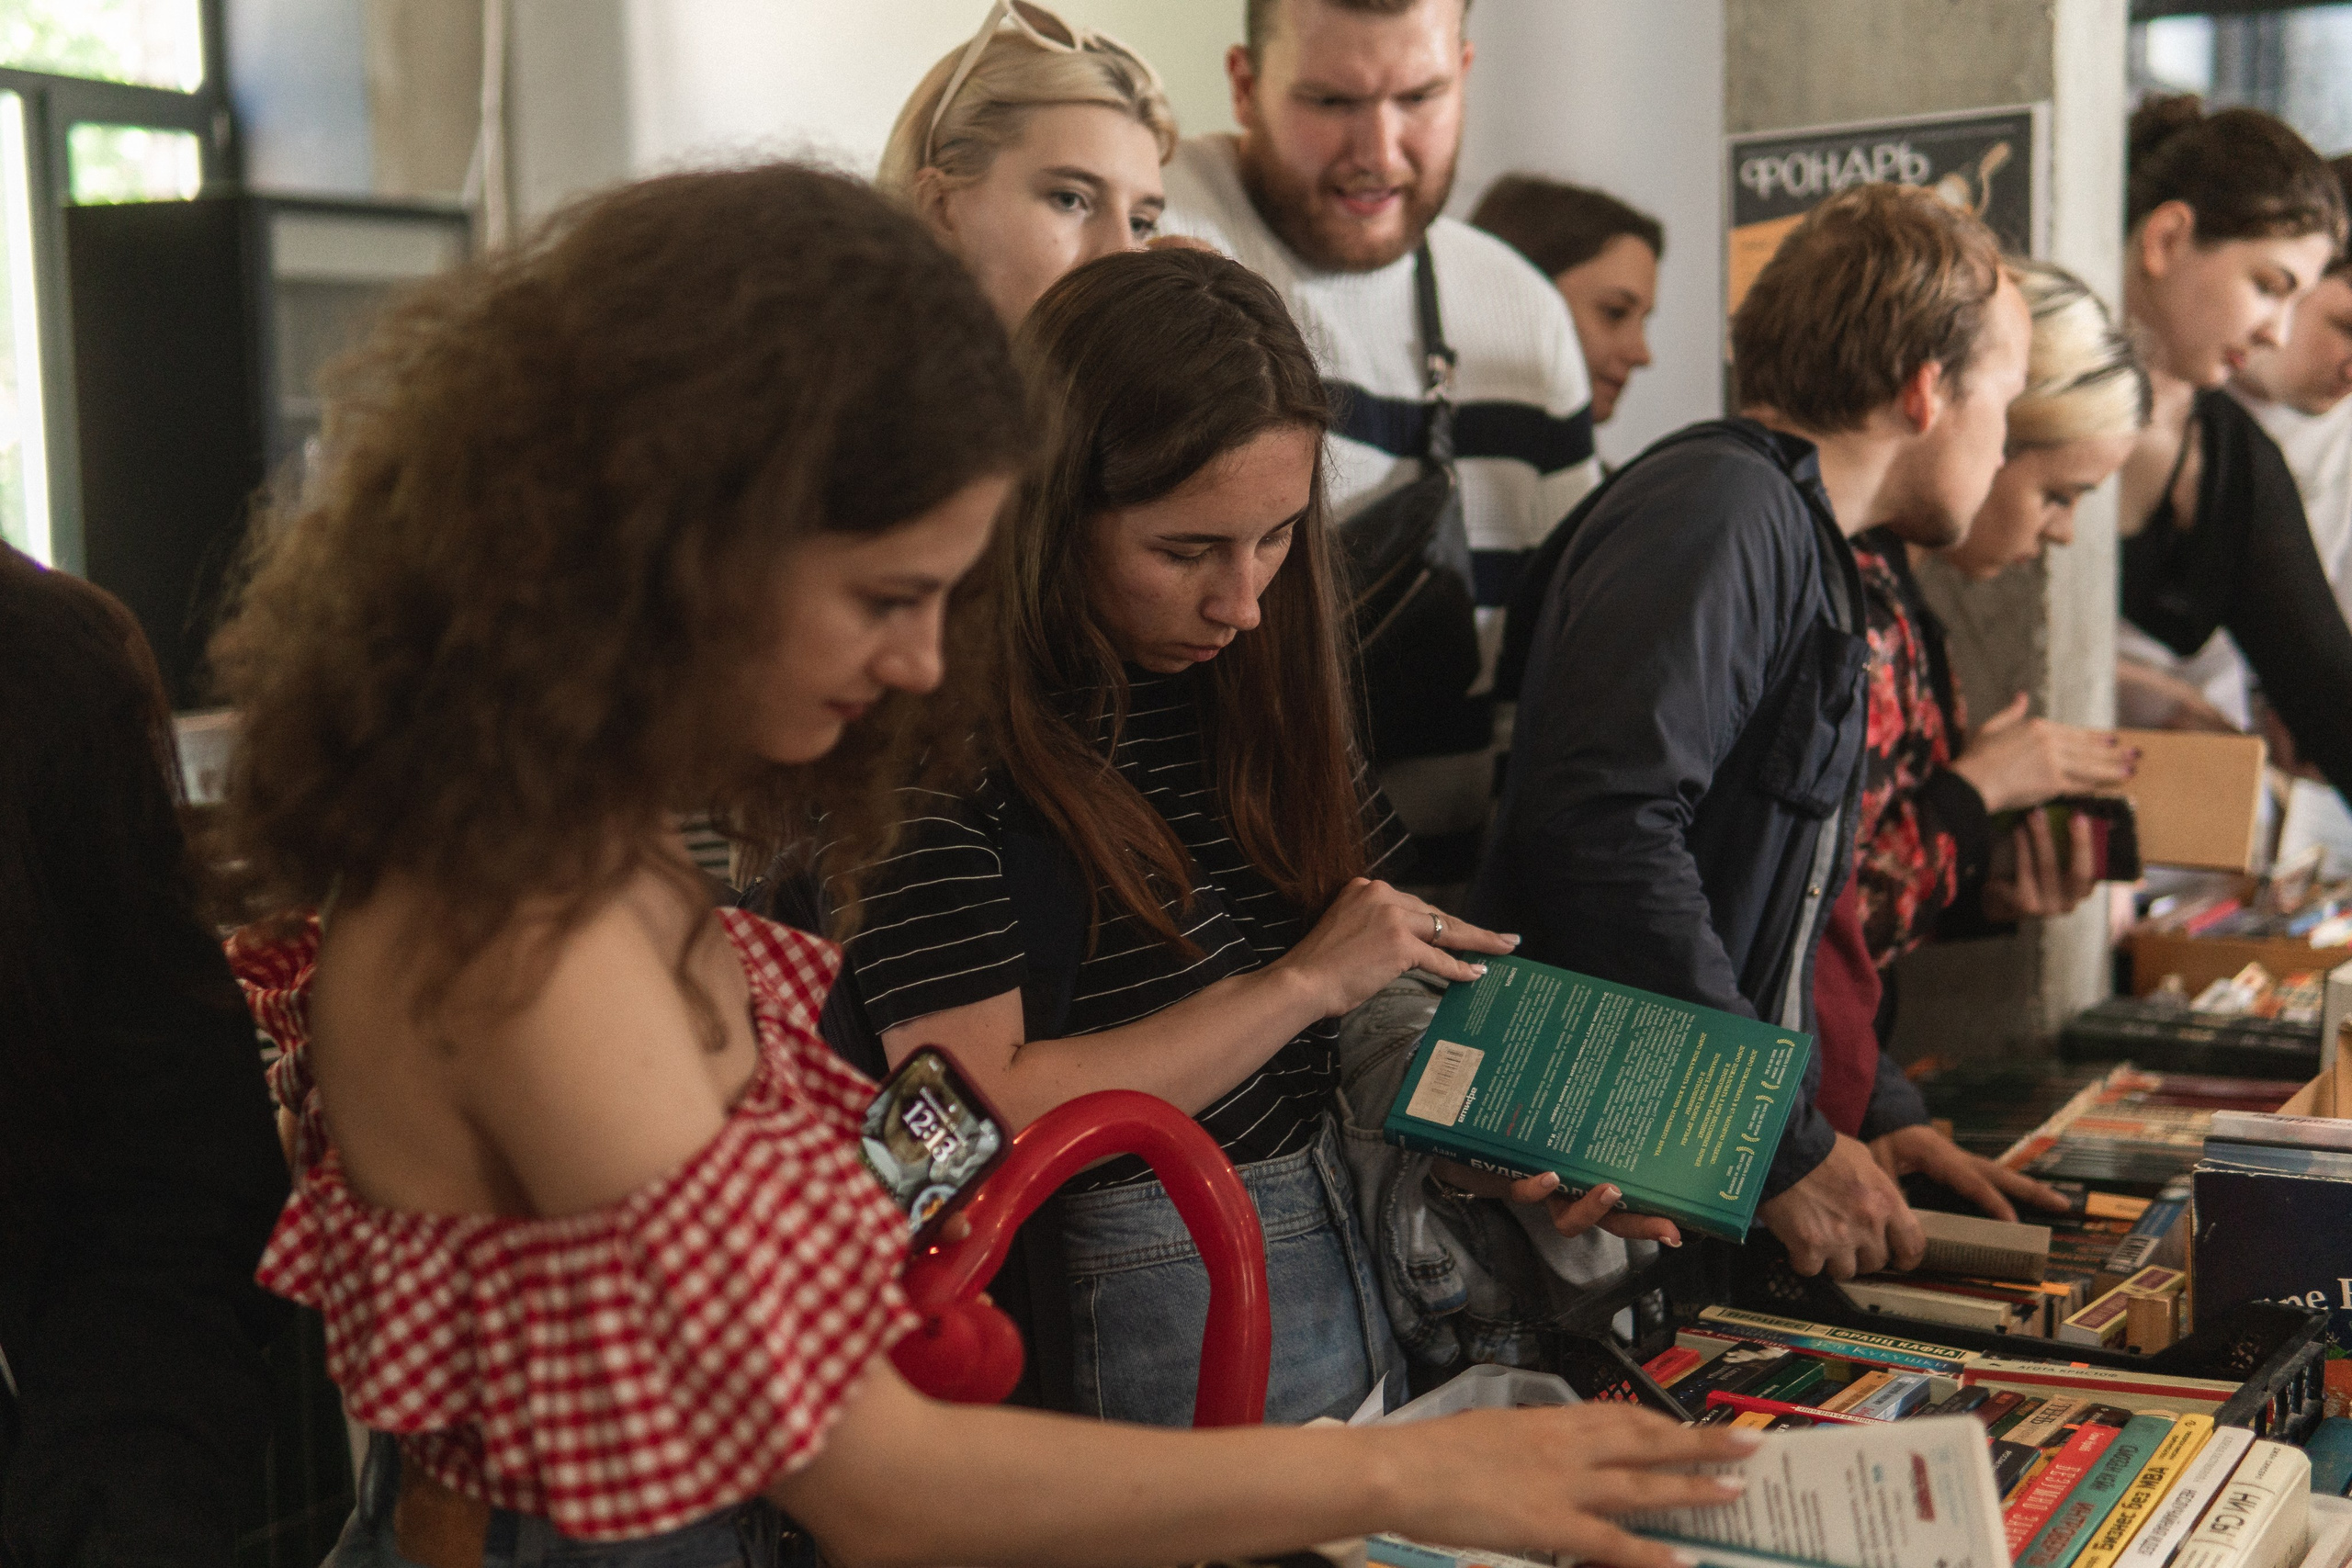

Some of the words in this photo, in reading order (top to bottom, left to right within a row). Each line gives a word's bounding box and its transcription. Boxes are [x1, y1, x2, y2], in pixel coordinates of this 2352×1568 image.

[1739, 141, 1931, 200] ФОНАРЬ
[1454, 1086, 1480, 1123] афиша
[902, 1099, 958, 1163] 12:13
[1430, 1145, 1458, 1158] Адам
[1834, 1328, 1893, 1348] ФРАНЦ
[1896, 1339, 1955, 1359] КАФКА
[1852, 1345, 1948, 1371] КУКУШКИ
[2017, 1363, 2054, 1373] АГОТА
[2059, 1366, 2118, 1380] КРИСТОФ
[2022, 1463, 2083, 1511] БЕЗУМНО
[2222, 1490, 2261, 1516] НИ
[2093, 1512, 2137, 1550] Бизнес
[2120, 1492, 2151, 1509] без
